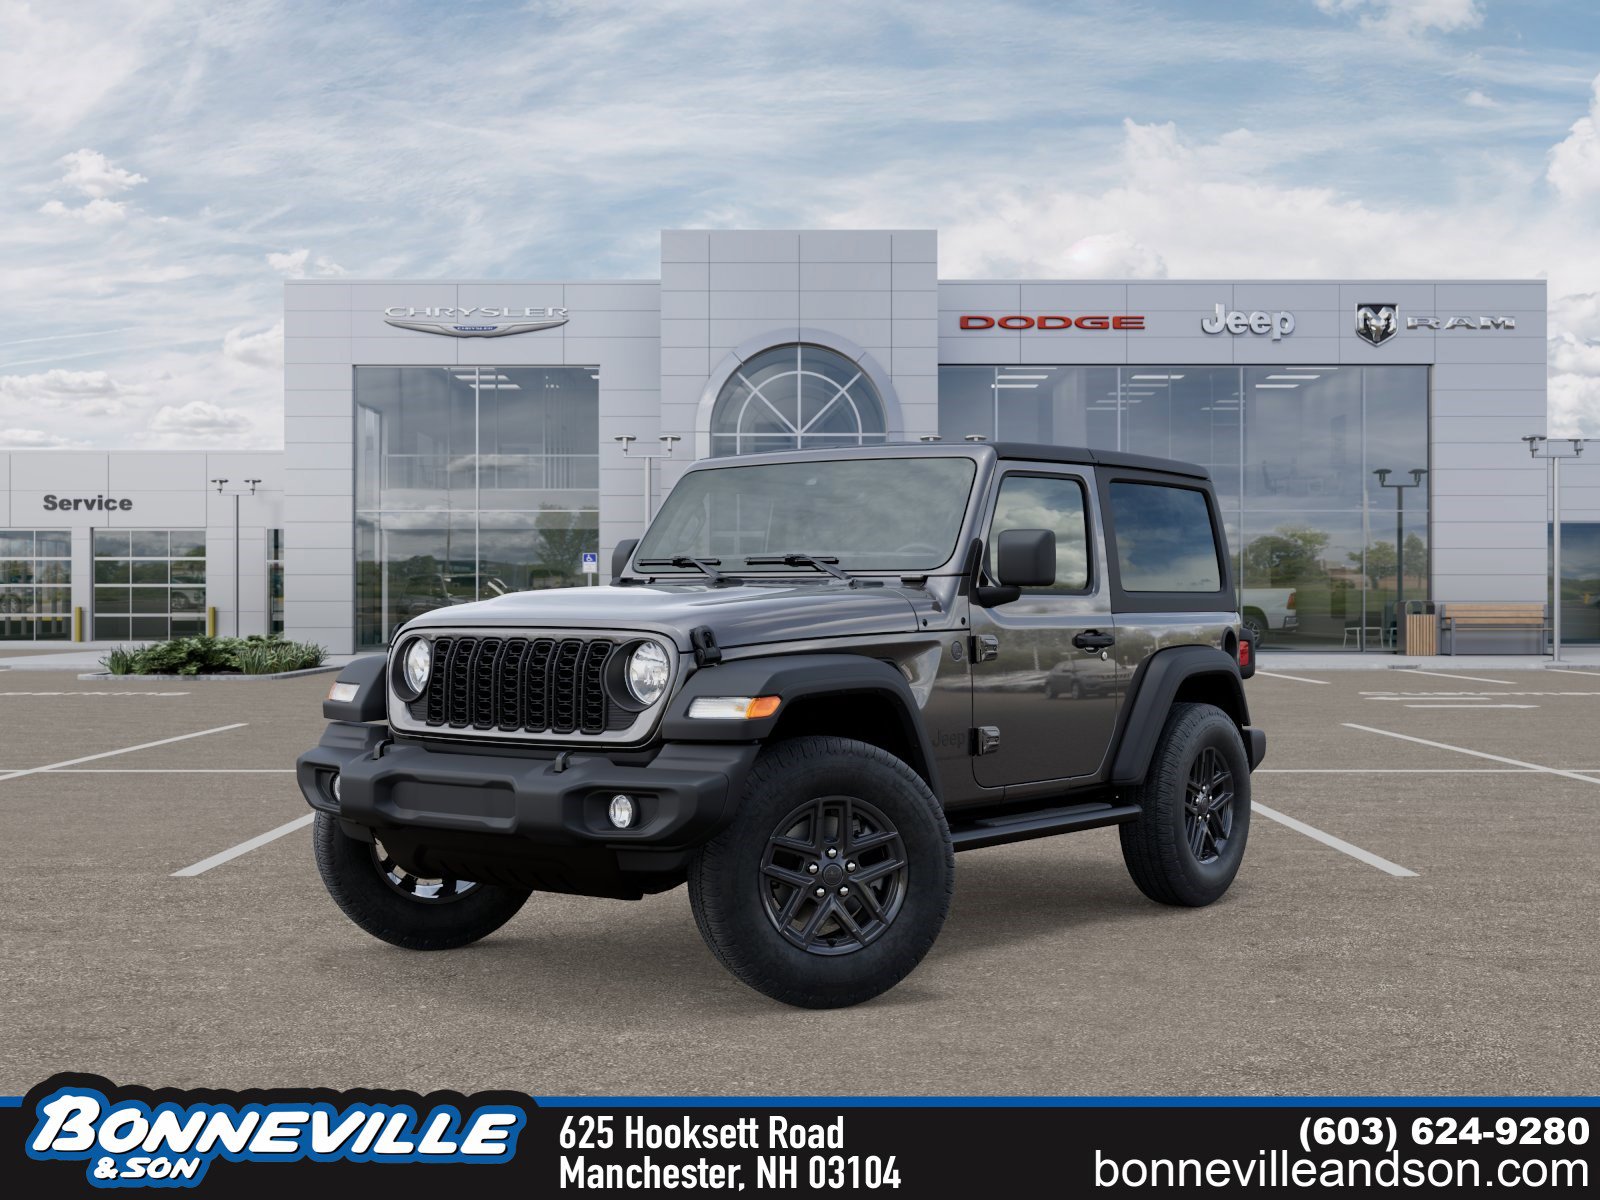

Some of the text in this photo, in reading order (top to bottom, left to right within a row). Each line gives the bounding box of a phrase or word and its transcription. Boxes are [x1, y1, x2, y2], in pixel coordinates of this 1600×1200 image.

[384, 306, 569, 317] CHRYSLER
[959, 315, 1145, 330] DODGE
[1201, 303, 1295, 341] Jeep
[1406, 316, 1516, 330] RAM
[43, 494, 133, 512] Service
[932, 728, 966, 748] Jeep
